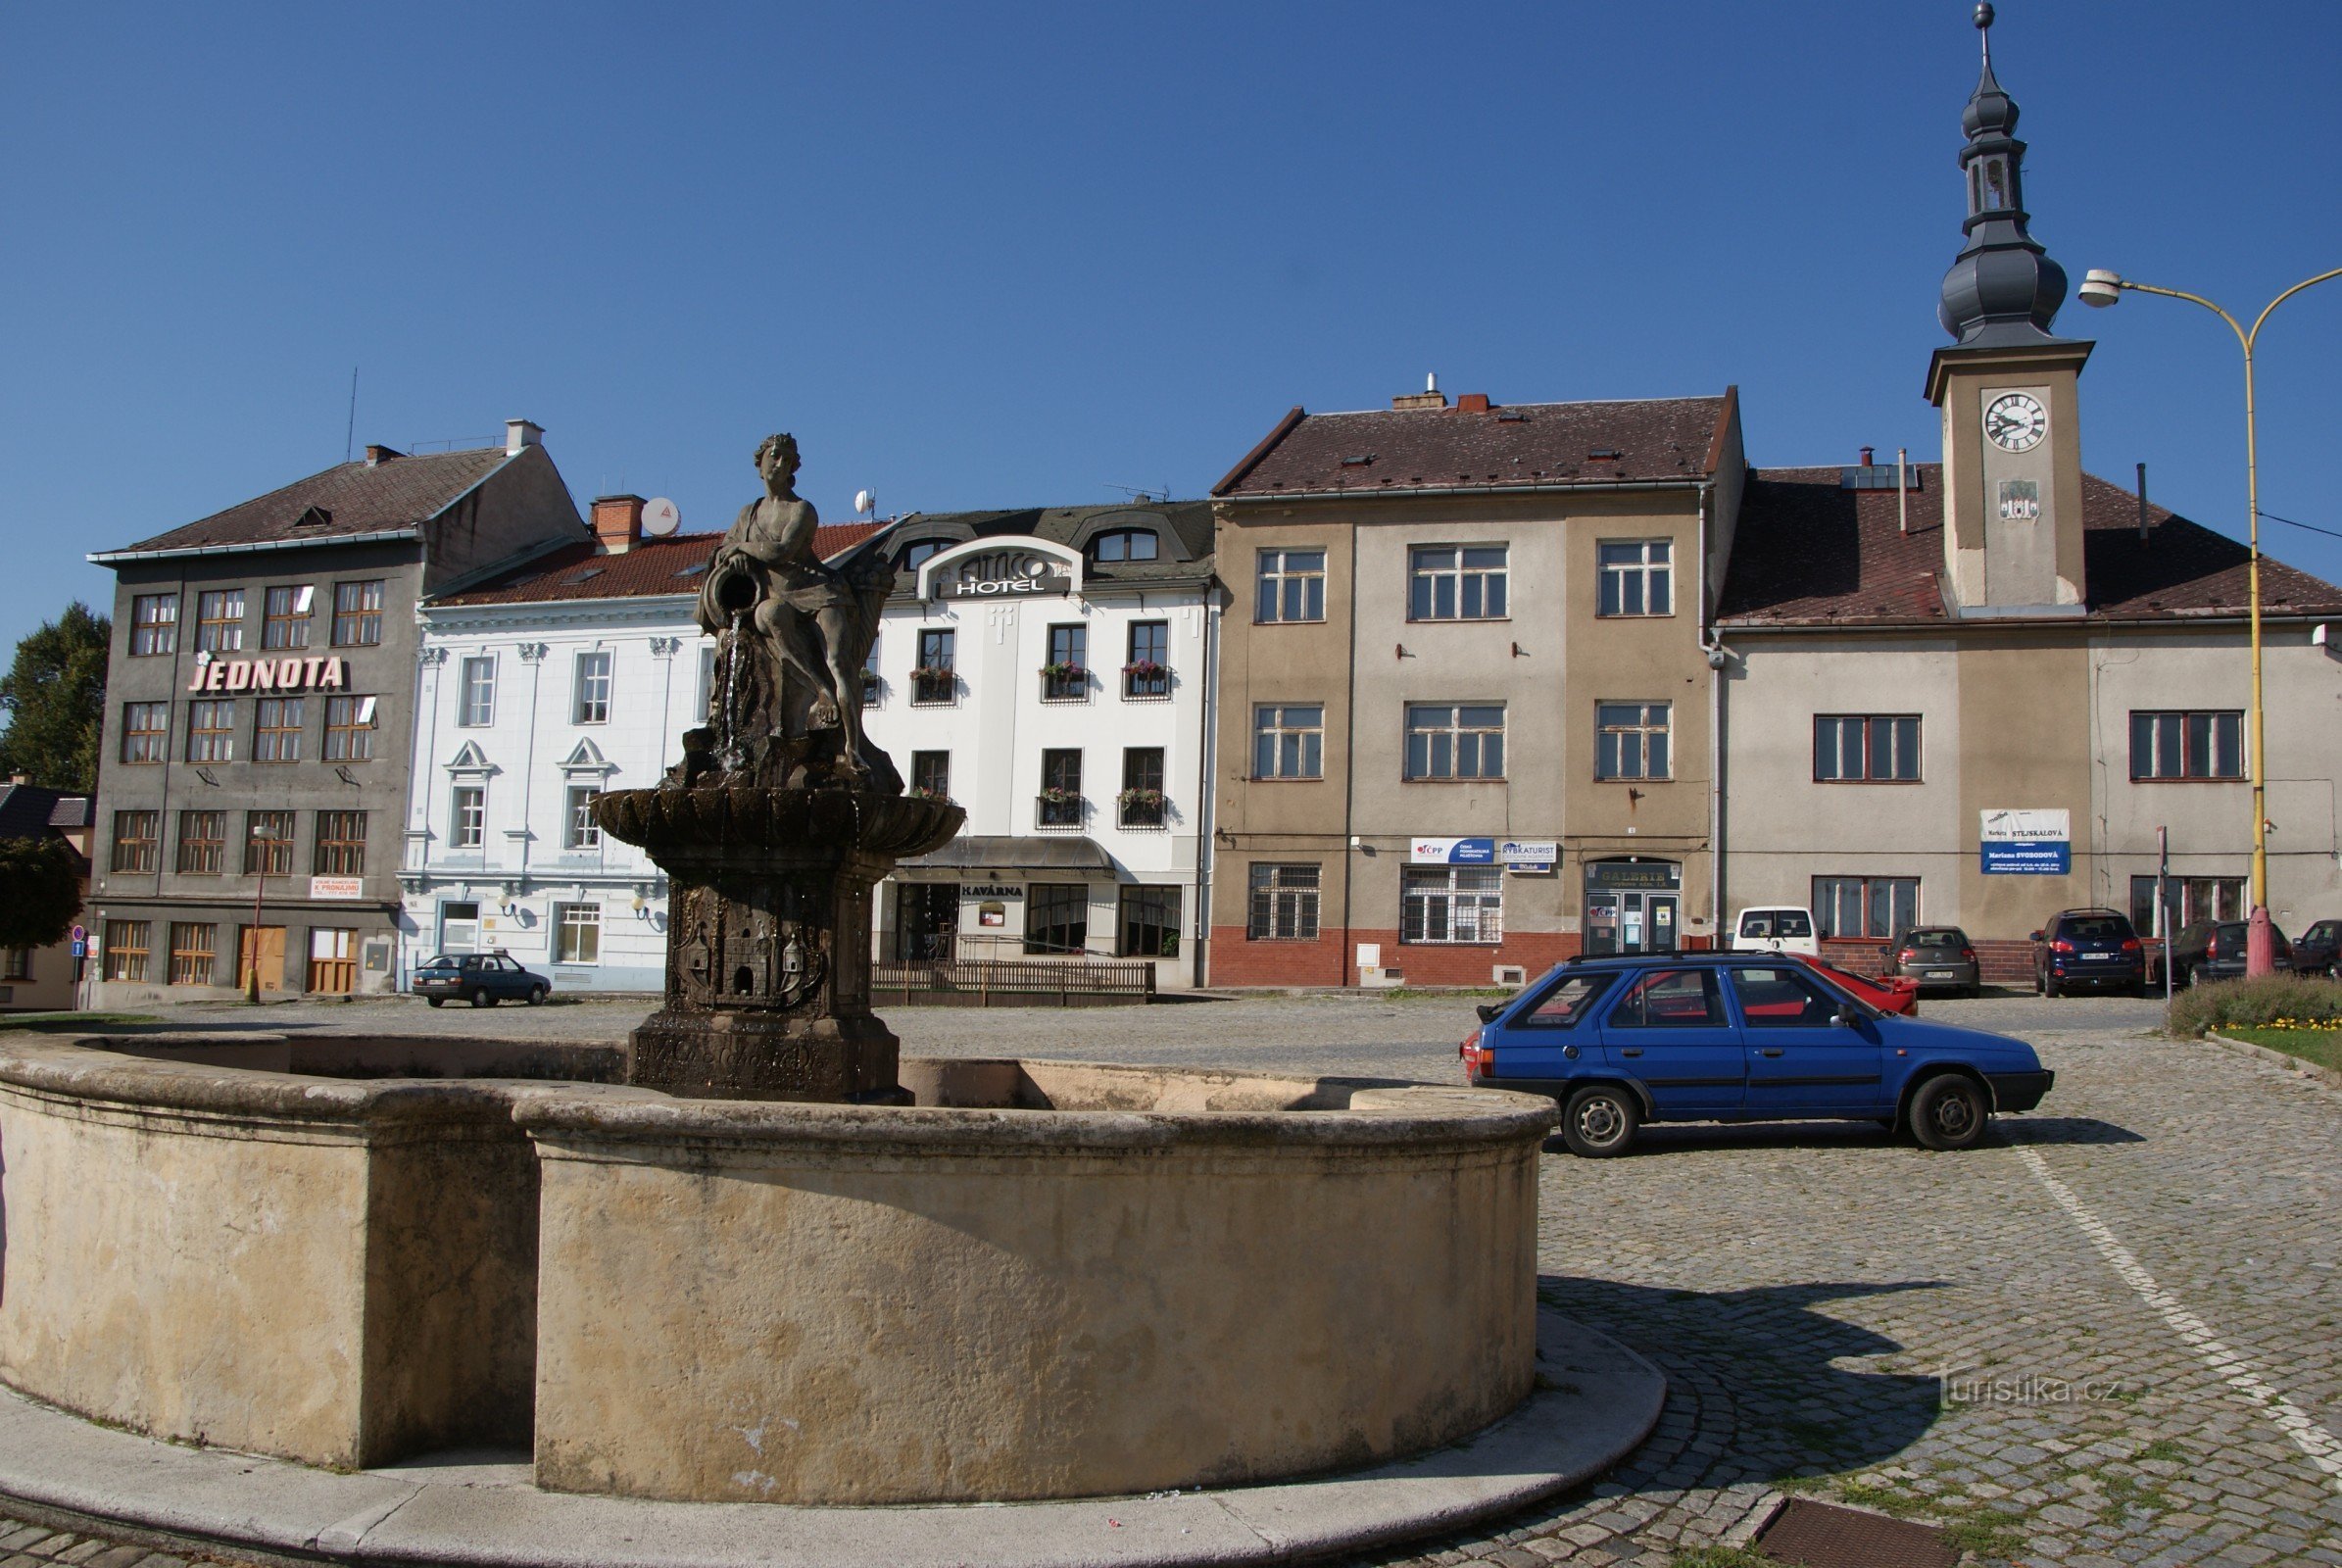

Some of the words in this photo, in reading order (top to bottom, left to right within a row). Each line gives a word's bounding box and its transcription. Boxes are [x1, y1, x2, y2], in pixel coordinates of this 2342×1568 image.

[956, 579, 1046, 595] HOTEL
[188, 657, 343, 691] JEDNOTA
[1602, 870, 1665, 882] GALERIE
[962, 884, 1023, 897] KAVÁRNA
